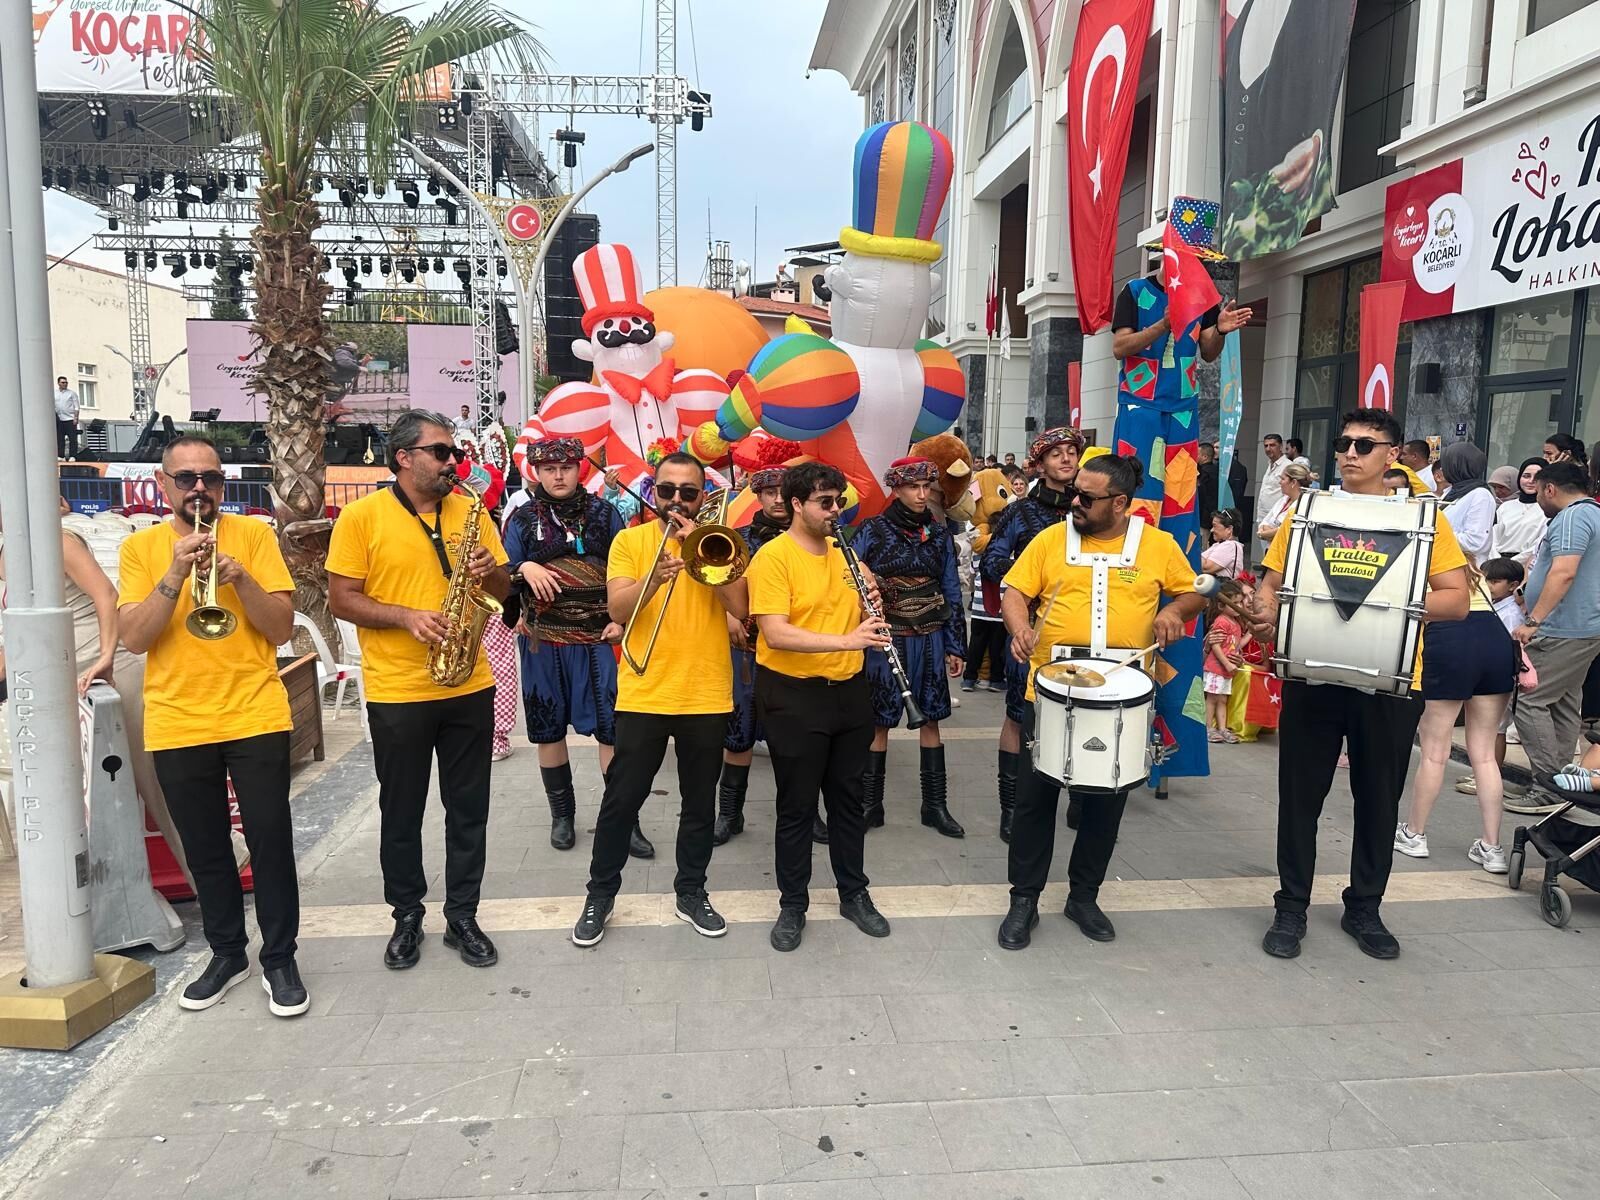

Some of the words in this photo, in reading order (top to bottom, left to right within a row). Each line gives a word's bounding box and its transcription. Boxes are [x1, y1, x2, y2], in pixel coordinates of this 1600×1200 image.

[1423, 243, 1462, 265] KOÇARLI
[1331, 549, 1380, 563] tralles
[1332, 565, 1374, 577] bandosu
